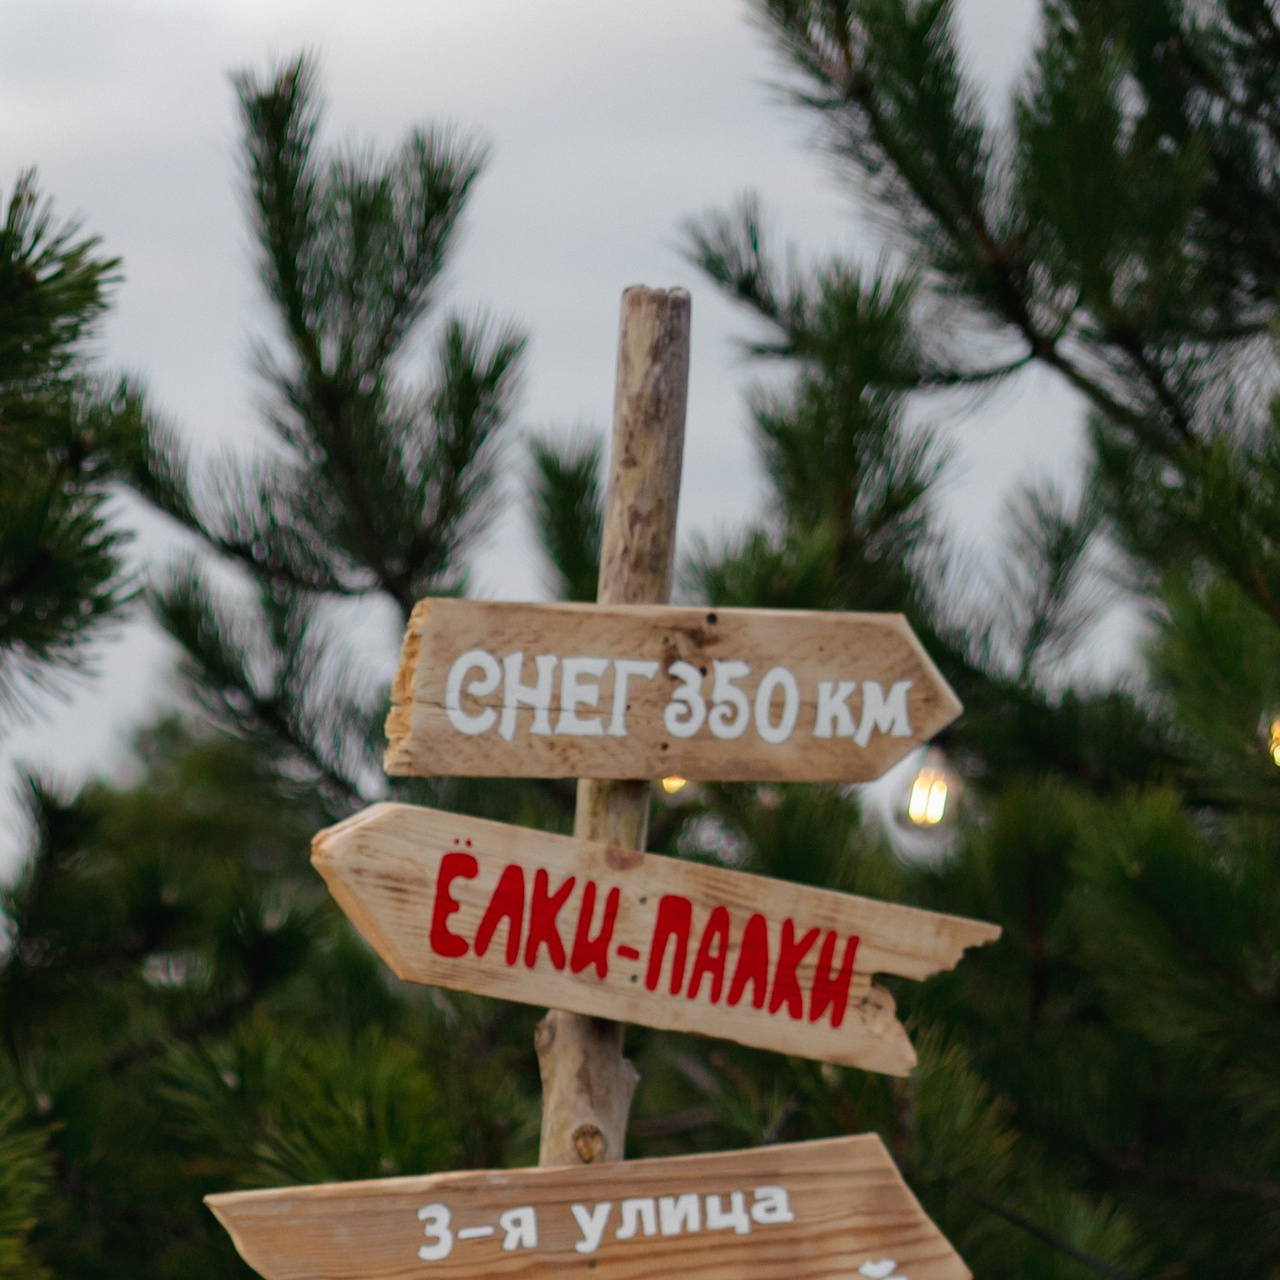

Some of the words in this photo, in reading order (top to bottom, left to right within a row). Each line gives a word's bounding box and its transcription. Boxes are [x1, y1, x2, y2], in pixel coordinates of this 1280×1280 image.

[445, 650, 658, 740] СНЕГ
[663, 659, 799, 744] 350
[429, 838, 860, 1028] ЁЛКИ-ПАЛКИ
[417, 1203, 539, 1261] 3-я
[572, 1186, 794, 1253] улица
